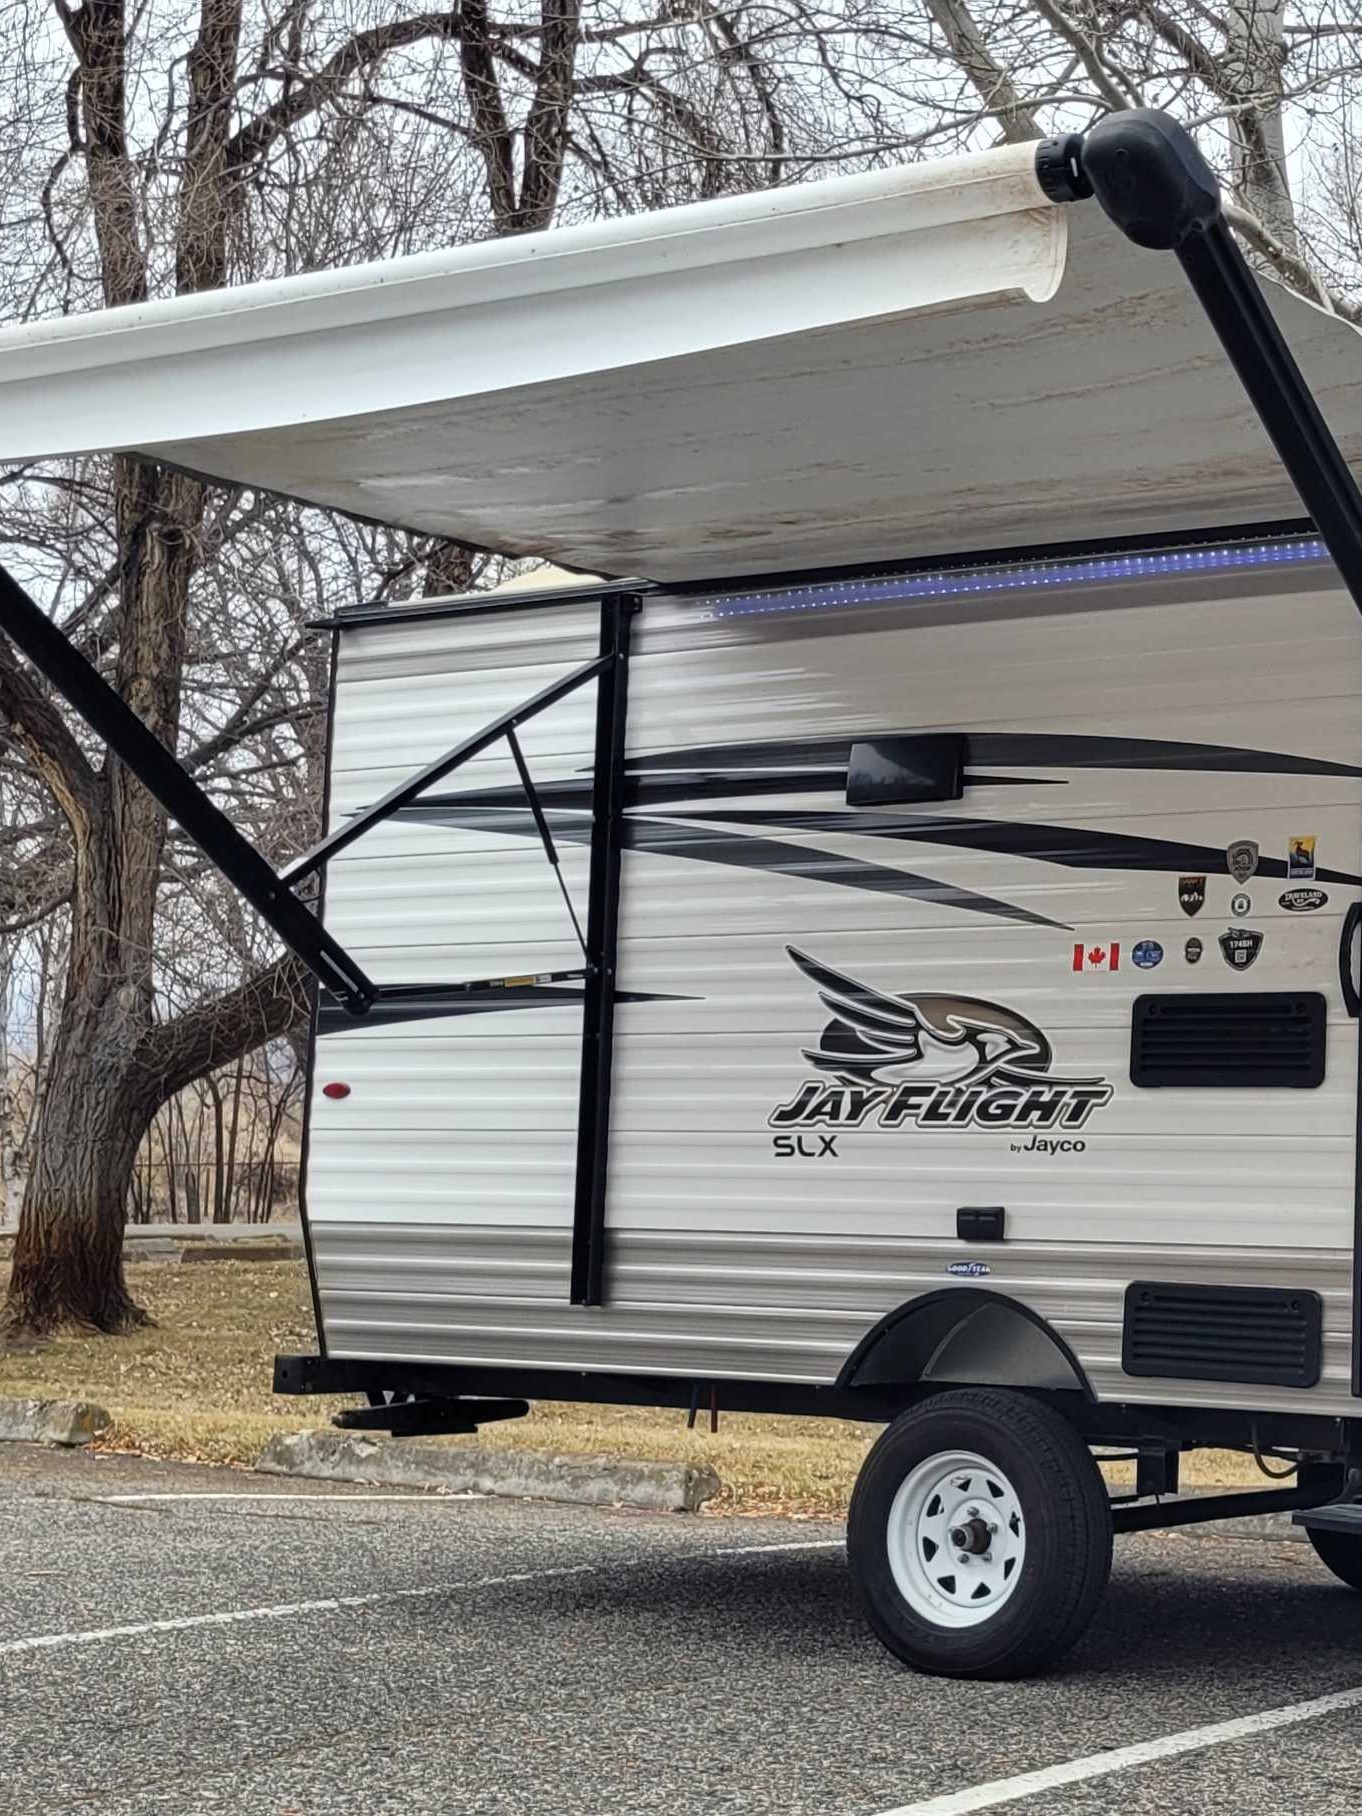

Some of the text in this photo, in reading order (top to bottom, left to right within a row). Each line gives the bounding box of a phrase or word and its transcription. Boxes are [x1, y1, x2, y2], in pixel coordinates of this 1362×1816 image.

[880, 1081, 1113, 1128] FLIGHT
[773, 1135, 838, 1157] SLX
[1010, 1135, 1086, 1155] by Jayco
